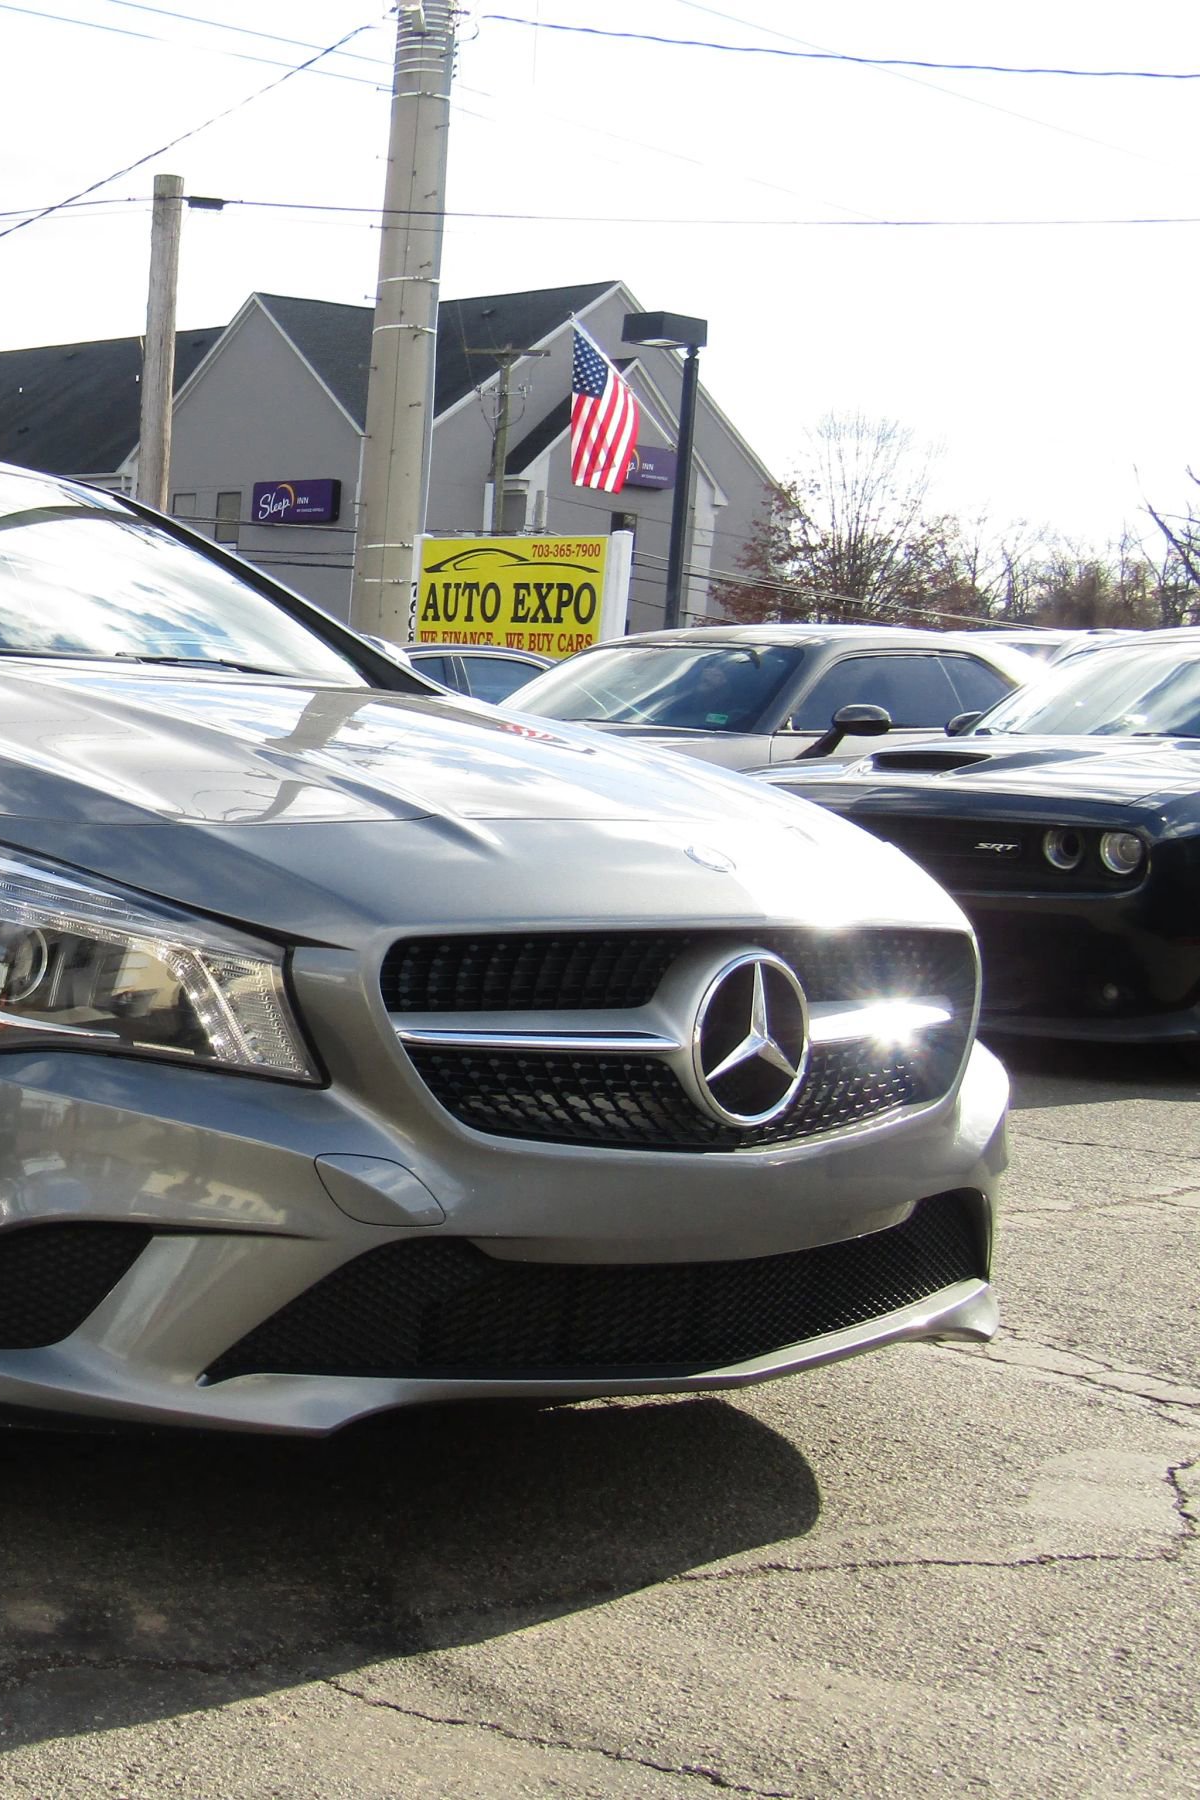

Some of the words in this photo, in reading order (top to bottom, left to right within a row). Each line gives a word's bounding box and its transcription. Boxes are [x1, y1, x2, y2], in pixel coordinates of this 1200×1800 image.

[258, 492, 290, 519] Sleep
[297, 497, 309, 505] INN
[531, 543, 601, 559] 703-365-7900
[421, 581, 501, 623] AUTO
[510, 582, 597, 625] EXPO
[420, 630, 438, 643] WE
[441, 631, 494, 645] FINANCE
[505, 632, 525, 650] WE
[527, 633, 554, 652] BUY
[557, 633, 593, 653] CARS
[974, 843, 1017, 852] SRT
